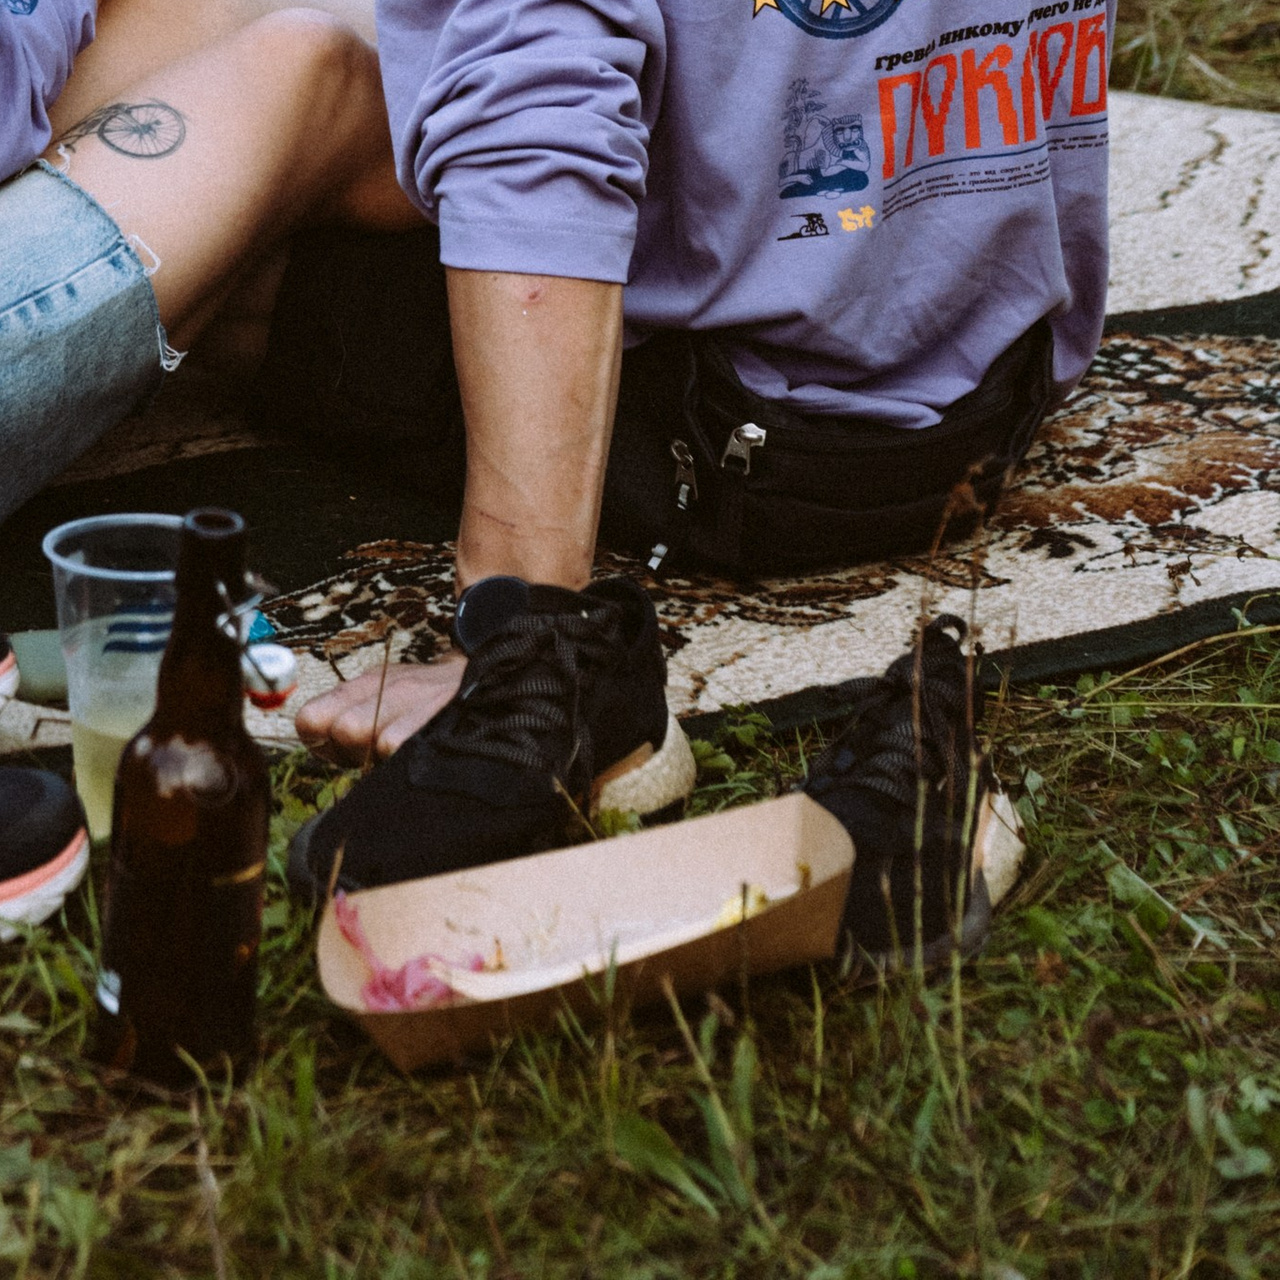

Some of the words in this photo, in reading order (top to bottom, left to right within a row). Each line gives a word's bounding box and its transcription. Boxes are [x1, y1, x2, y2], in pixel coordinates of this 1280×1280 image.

[938, 18, 1025, 48] никому
[1027, 0, 1070, 30] ичего
[876, 11, 1108, 181] ПОКОВ
